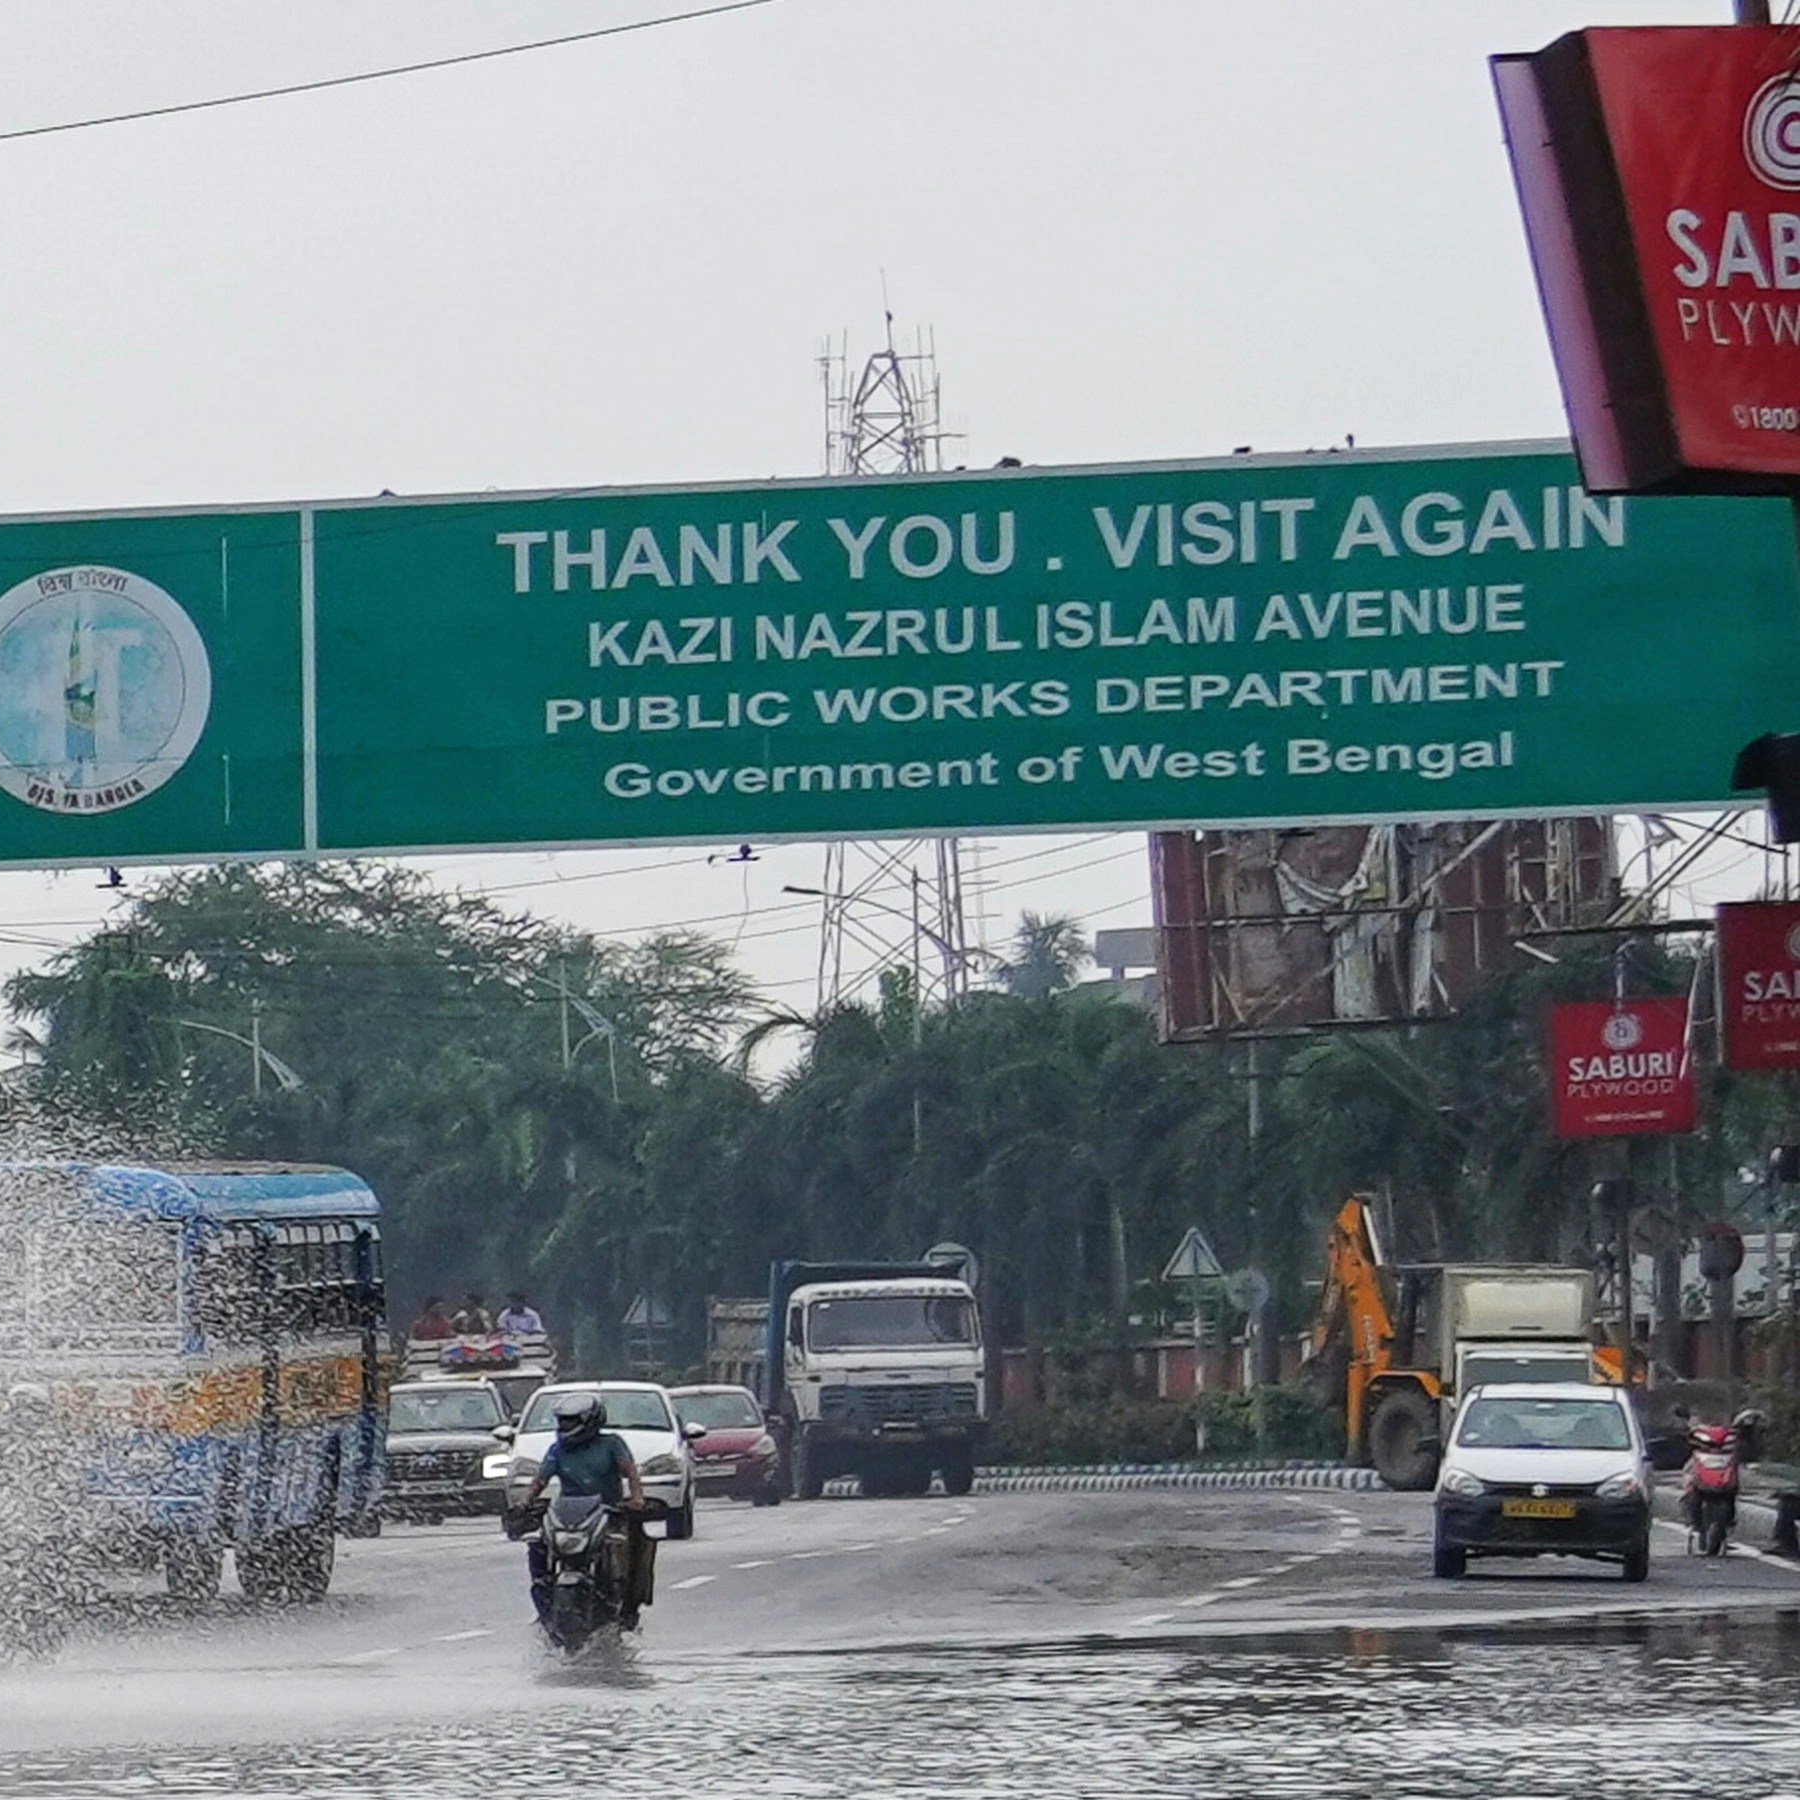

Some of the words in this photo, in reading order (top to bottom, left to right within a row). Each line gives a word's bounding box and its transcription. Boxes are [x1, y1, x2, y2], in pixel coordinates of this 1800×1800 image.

[496, 519, 801, 593] THANK
[827, 510, 1016, 580] YOU
[1093, 497, 1317, 569] VISIT
[1333, 485, 1625, 560] AGAIN
[588, 616, 733, 668] KAZI
[755, 605, 1021, 661] NAZRUL
[1036, 597, 1236, 650] ISLAM
[1254, 583, 1526, 643] AVENUE
[545, 690, 791, 734] PUBLIC
[813, 679, 1070, 725] WORKS
[1096, 660, 1565, 714] DEPARTMENT
[603, 748, 999, 799] Government
[1017, 745, 1084, 784] of
[1099, 740, 1266, 781] West
[1287, 730, 1514, 780] Bengal
[1566, 1079, 1674, 1098] PLYWOOD
[1568, 1052, 1673, 1082] SABURI
